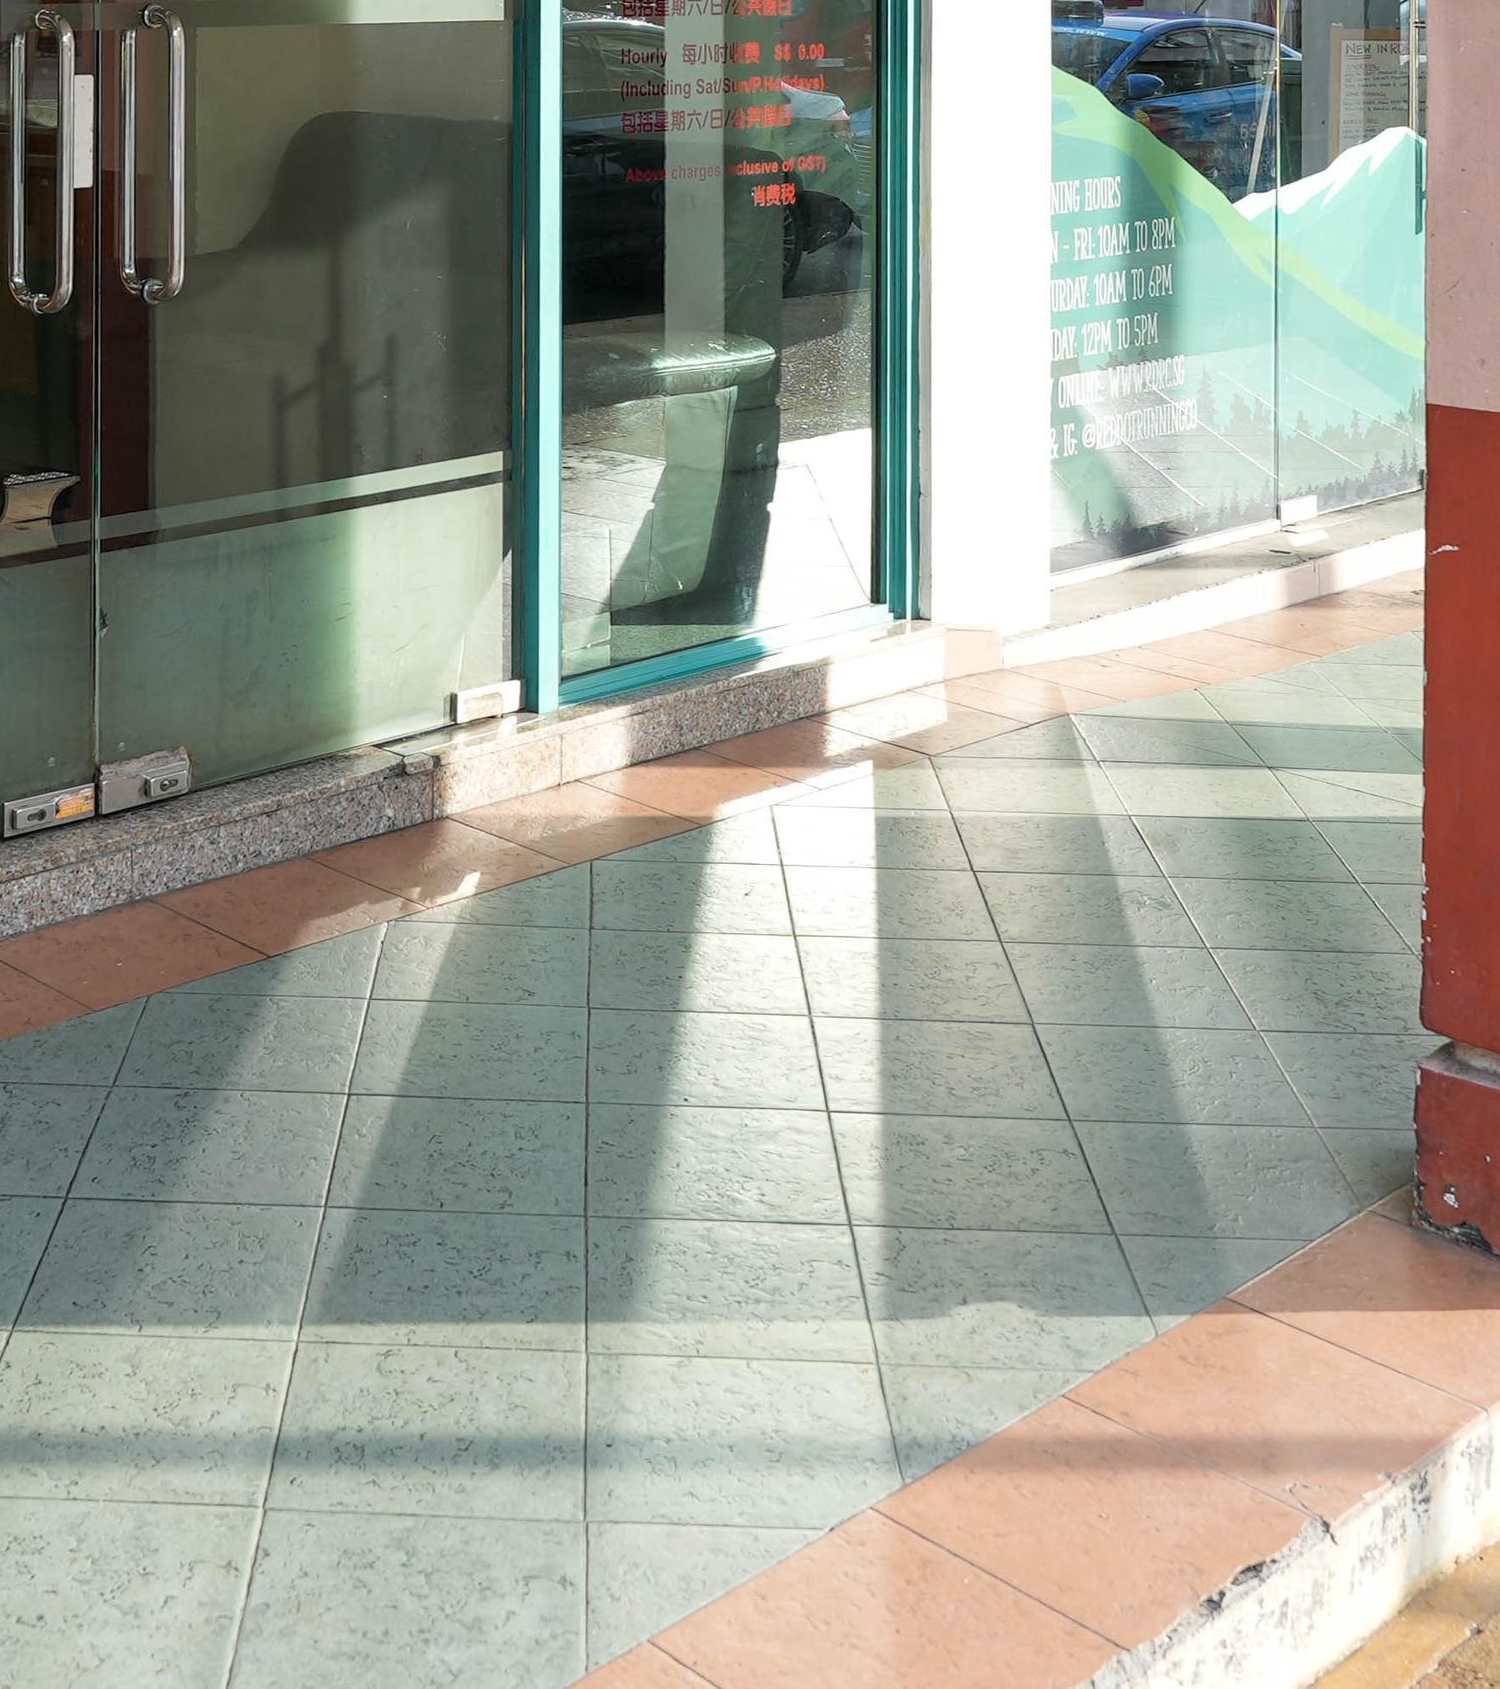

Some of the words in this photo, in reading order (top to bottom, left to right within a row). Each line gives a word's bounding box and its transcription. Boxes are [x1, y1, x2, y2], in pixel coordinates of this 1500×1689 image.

[620, 48, 667, 67] Hourly
[1346, 43, 1371, 54] NEW
[620, 78, 691, 102] (Including
[671, 164, 721, 182] charges
[782, 158, 793, 173] of
[1085, 176, 1121, 211] HOURS
[1097, 222, 1130, 258] 10AM
[1134, 219, 1148, 253] TO
[1152, 217, 1176, 251] 8PM
[1051, 275, 1090, 313] URDAY:
[1093, 269, 1127, 307] 10AM
[1131, 268, 1145, 301] TO
[1148, 264, 1174, 297] 6PM
[1051, 325, 1078, 361] DAY:
[1081, 318, 1113, 356] 12PM
[1116, 317, 1130, 351] TO
[1134, 312, 1160, 347] 5PM
[1063, 422, 1079, 458] IG:
